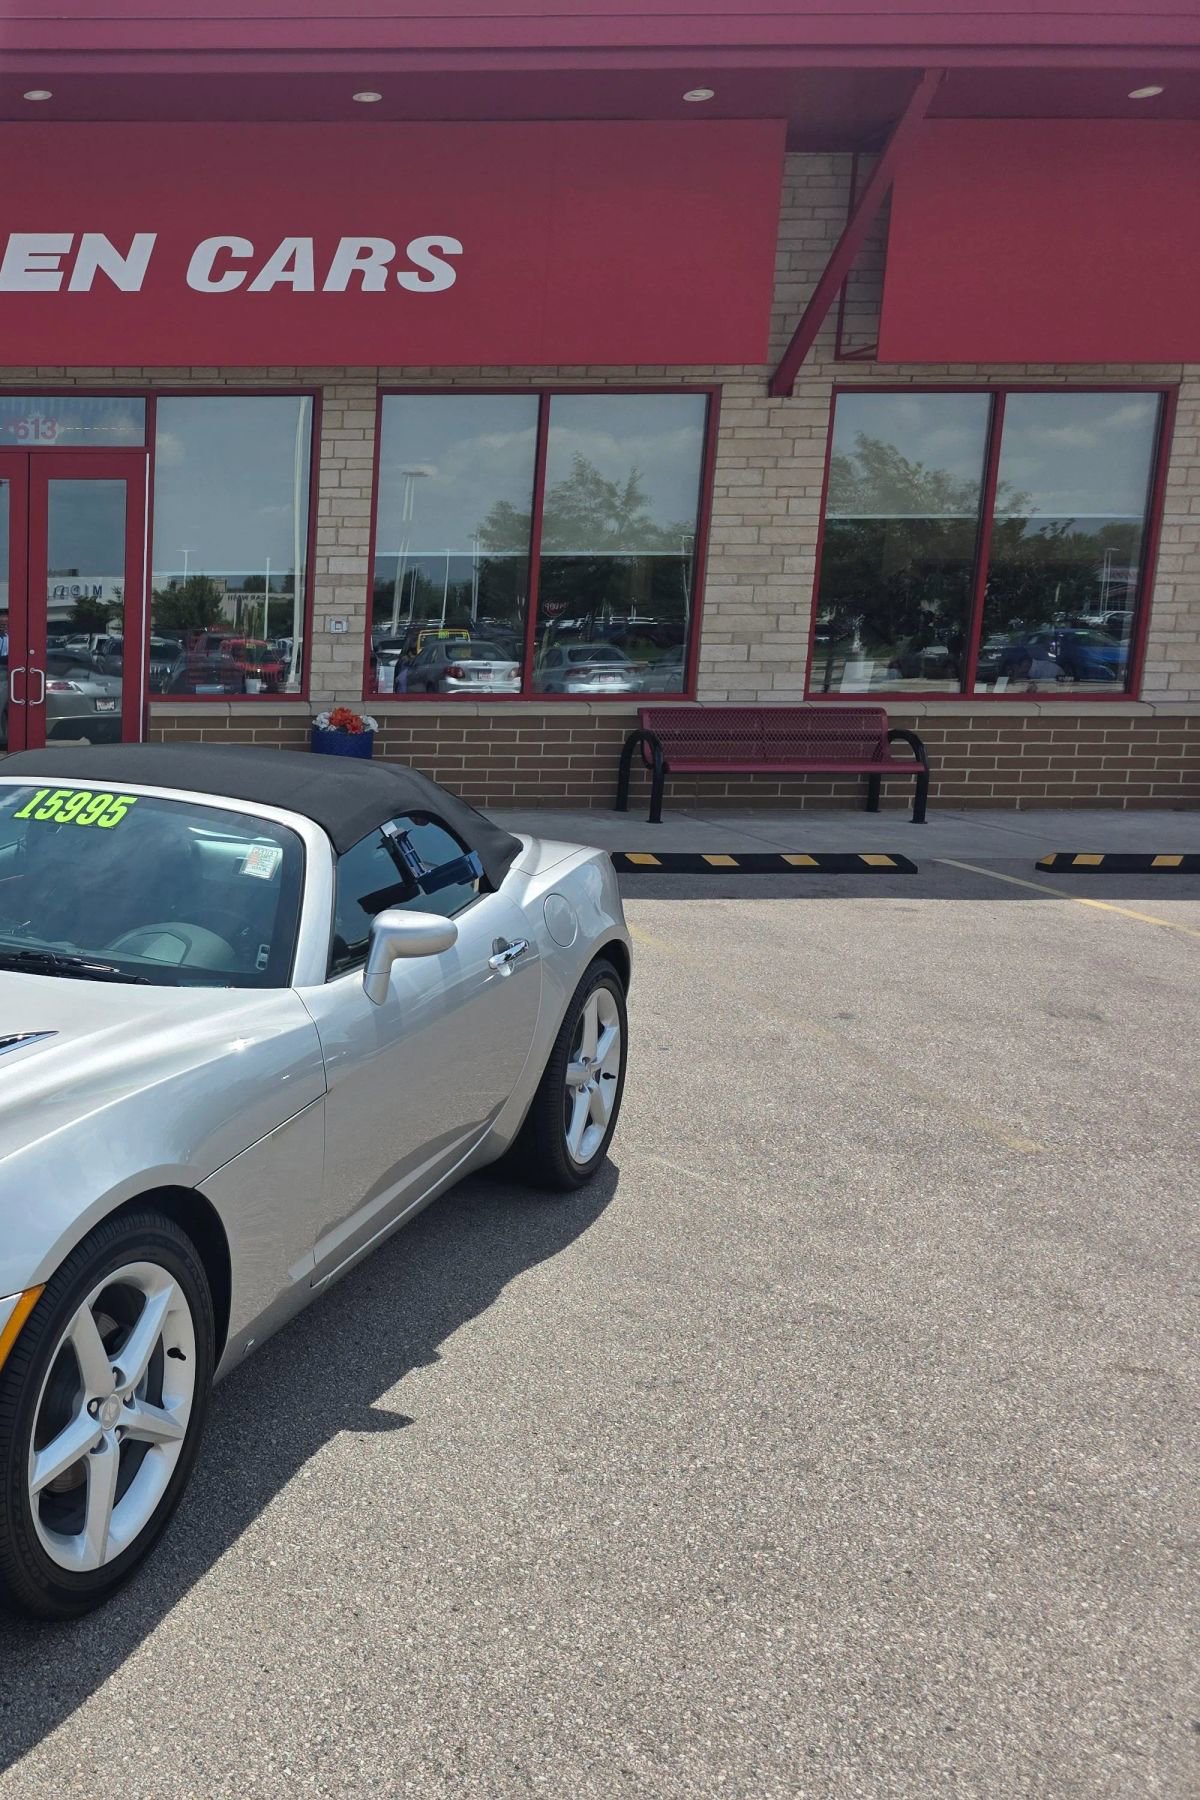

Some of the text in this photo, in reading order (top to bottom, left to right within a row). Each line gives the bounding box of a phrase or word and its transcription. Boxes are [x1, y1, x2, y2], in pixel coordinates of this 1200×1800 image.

[186, 235, 464, 293] CARS
[15, 416, 58, 440] 613
[13, 788, 139, 828] 15995
